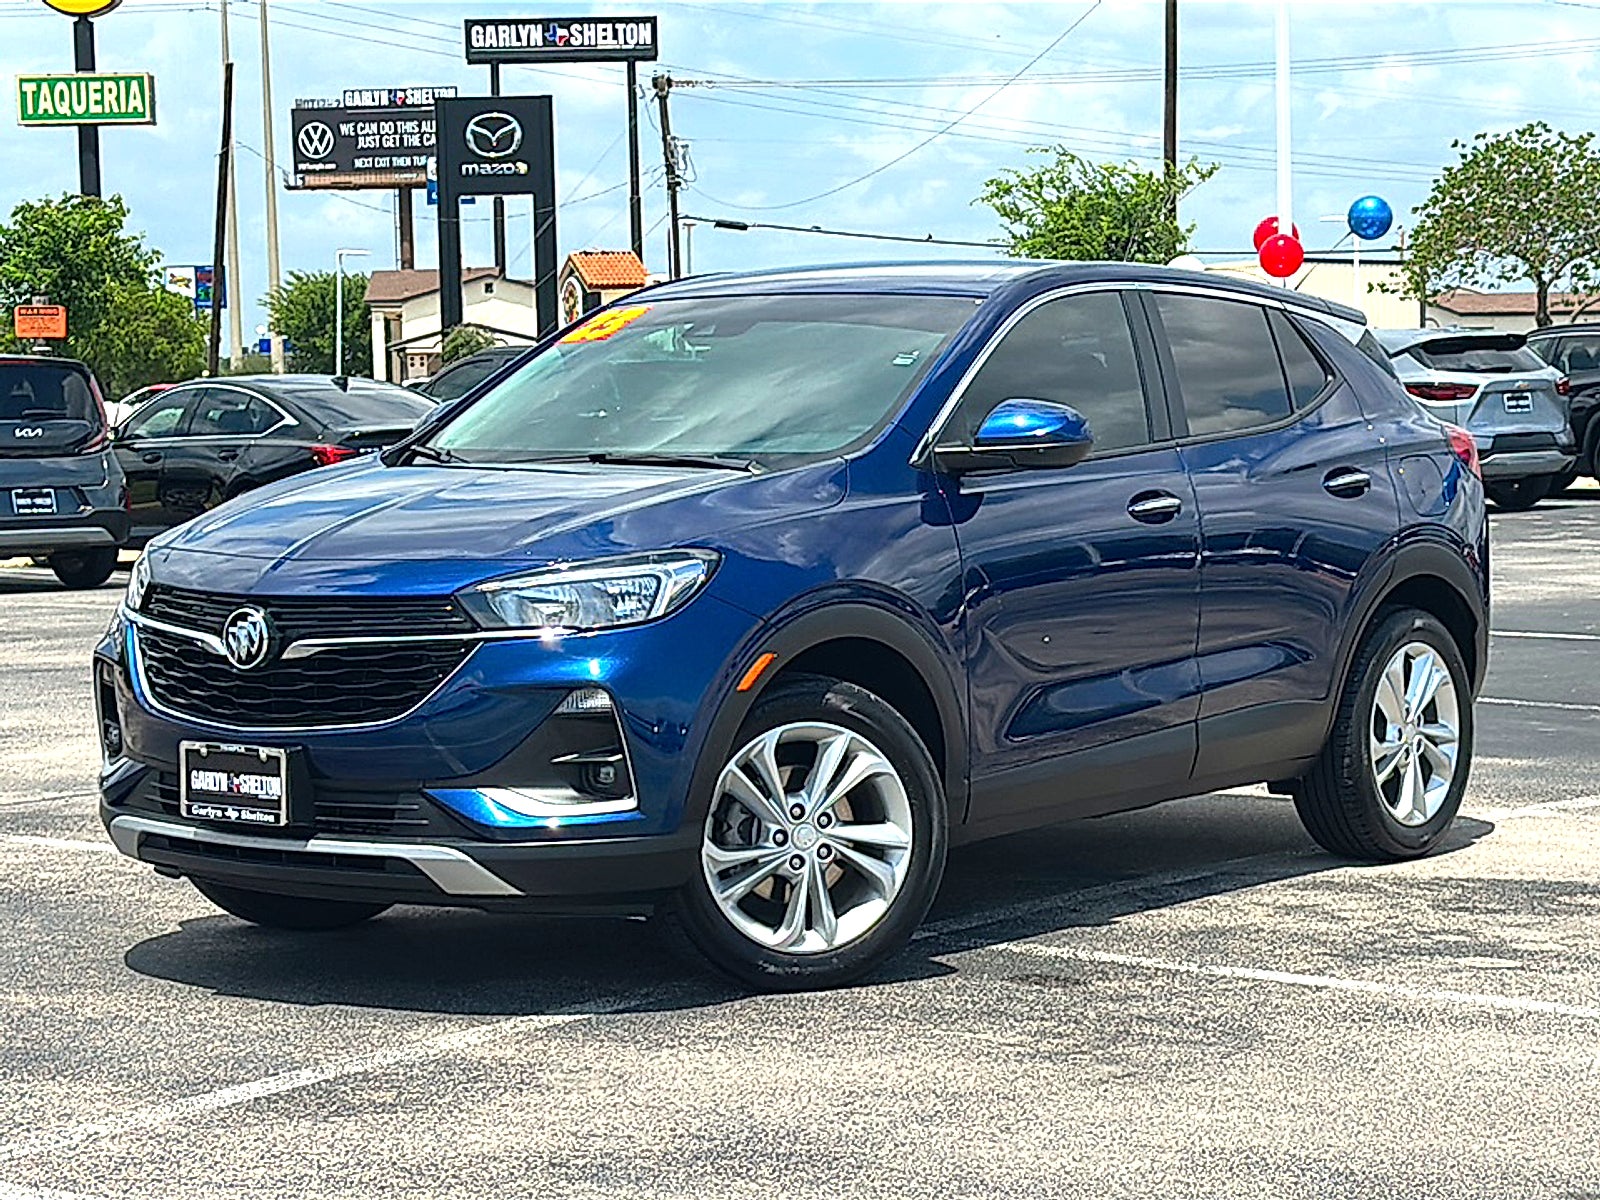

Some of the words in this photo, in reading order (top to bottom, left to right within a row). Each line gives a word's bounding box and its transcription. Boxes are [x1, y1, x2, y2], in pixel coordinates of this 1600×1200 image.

[470, 25, 543, 48] GARLYN
[569, 23, 651, 46] SHELTON
[21, 80, 144, 116] TAQUERIA
[345, 90, 389, 107] GARLYN
[405, 88, 456, 105] SHELTON
[339, 122, 355, 136] WE
[357, 121, 378, 135] CAN
[379, 121, 395, 134] DO
[396, 120, 419, 134] THIS
[357, 135, 380, 149] JUST
[381, 134, 400, 148] GET
[402, 133, 421, 147] THE
[423, 133, 436, 146] CA
[354, 156, 373, 168] NEXT
[374, 156, 390, 168] EXIT
[191, 770, 228, 792] GARLYN
[239, 774, 281, 796] SHELTON
[191, 805, 222, 819] Garlyn
[241, 809, 275, 823] Shelton
